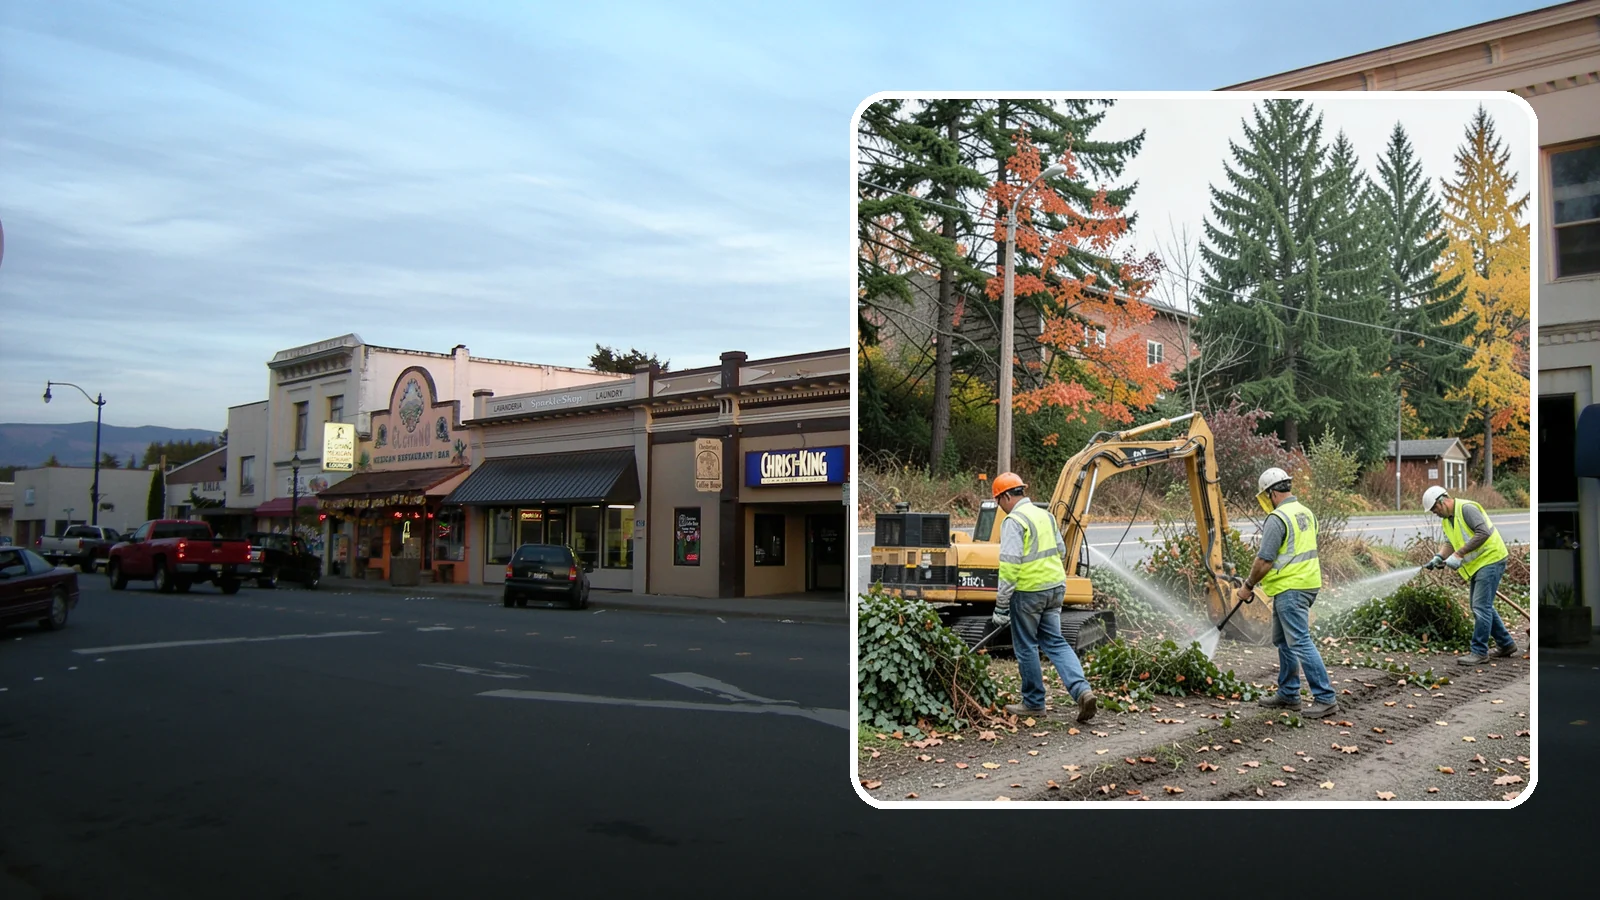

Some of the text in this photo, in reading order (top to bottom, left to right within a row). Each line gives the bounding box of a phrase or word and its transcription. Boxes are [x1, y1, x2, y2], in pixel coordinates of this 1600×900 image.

[530, 394, 583, 409] Sparkle Shop
[595, 388, 624, 400] LAUNDRY
[493, 401, 523, 413] LAVANDERIA
[373, 454, 397, 465] MEXICAN
[397, 451, 434, 463] RESTAURANT
[438, 449, 450, 460] BAR
[761, 450, 827, 478] CHRIST KING
